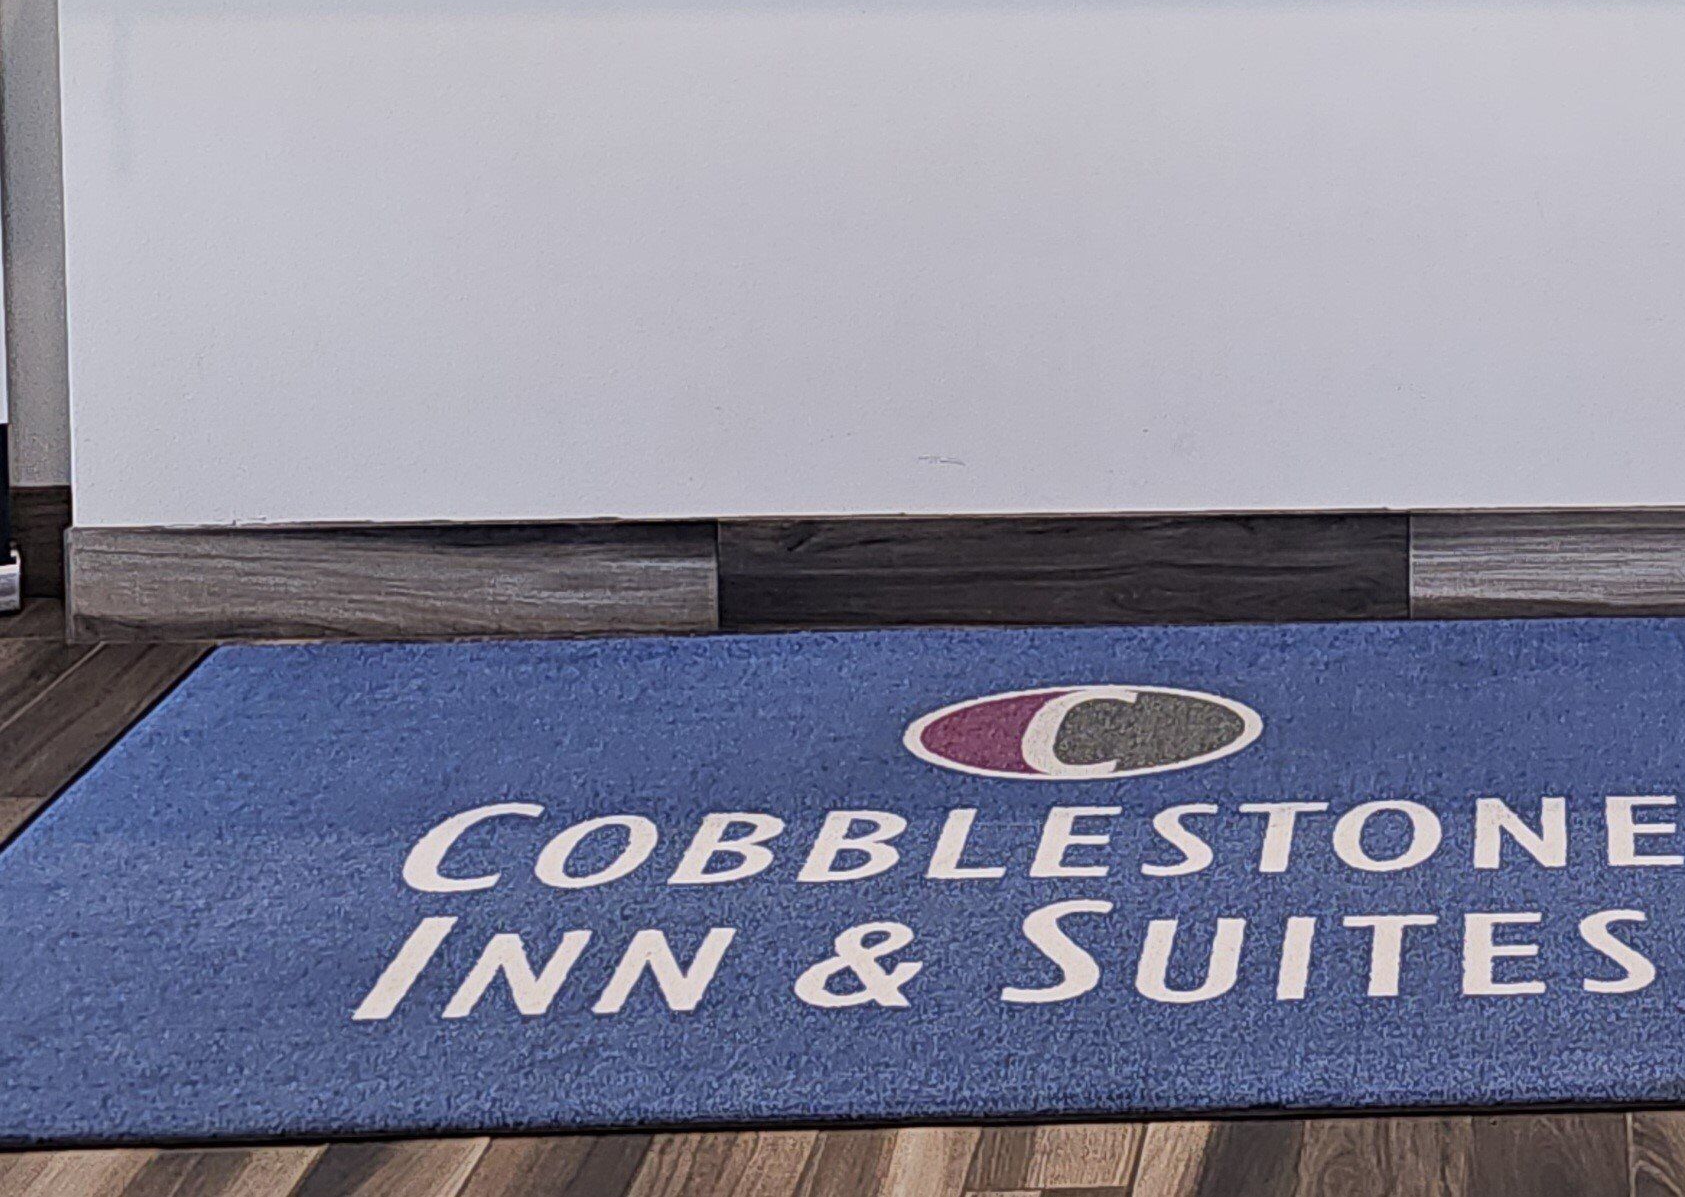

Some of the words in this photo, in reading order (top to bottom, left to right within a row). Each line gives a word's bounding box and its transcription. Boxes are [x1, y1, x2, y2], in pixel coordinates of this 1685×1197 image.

[402, 796, 1685, 892] COBBLESTONE
[352, 917, 738, 1021] INN
[792, 921, 925, 1009] &
[999, 901, 1660, 1006] SUITES
